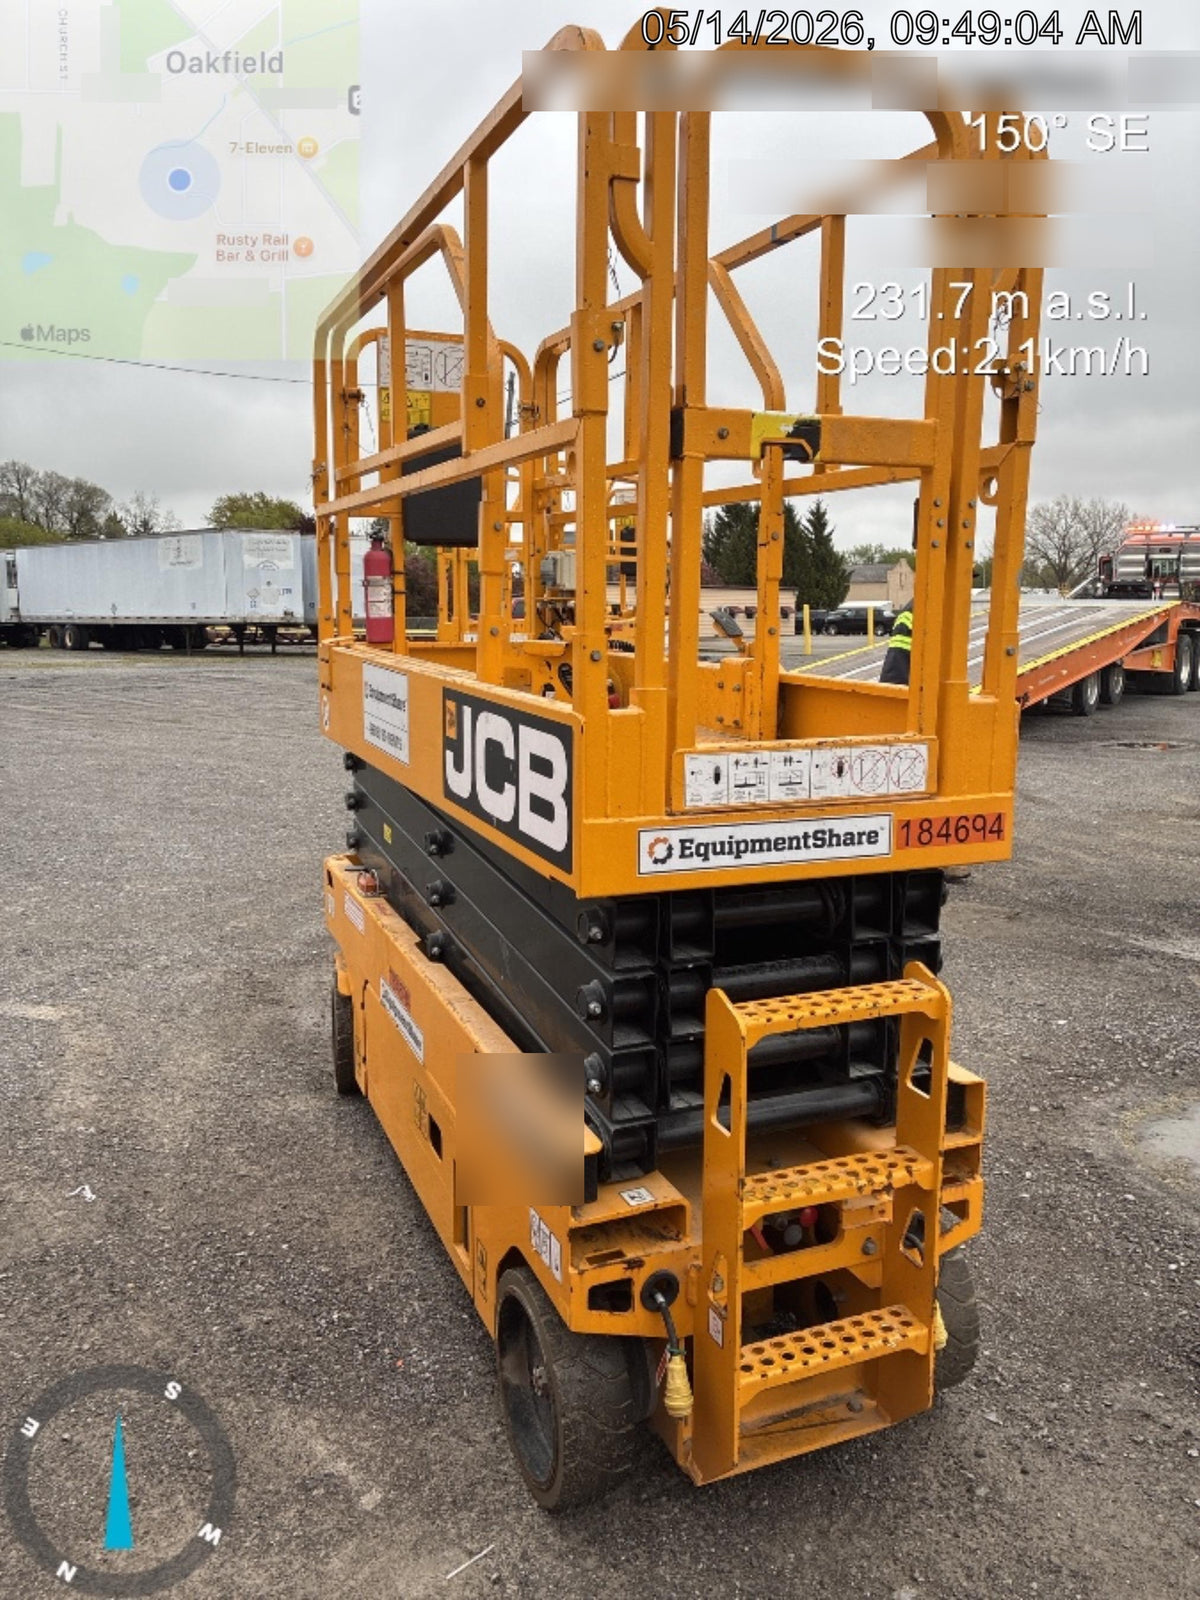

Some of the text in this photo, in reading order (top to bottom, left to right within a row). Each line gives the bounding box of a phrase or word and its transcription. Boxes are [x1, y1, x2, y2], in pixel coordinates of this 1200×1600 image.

[445, 704, 568, 853] JCB
[678, 828, 880, 861] EquipmentShare
[901, 813, 1004, 848] 184694
